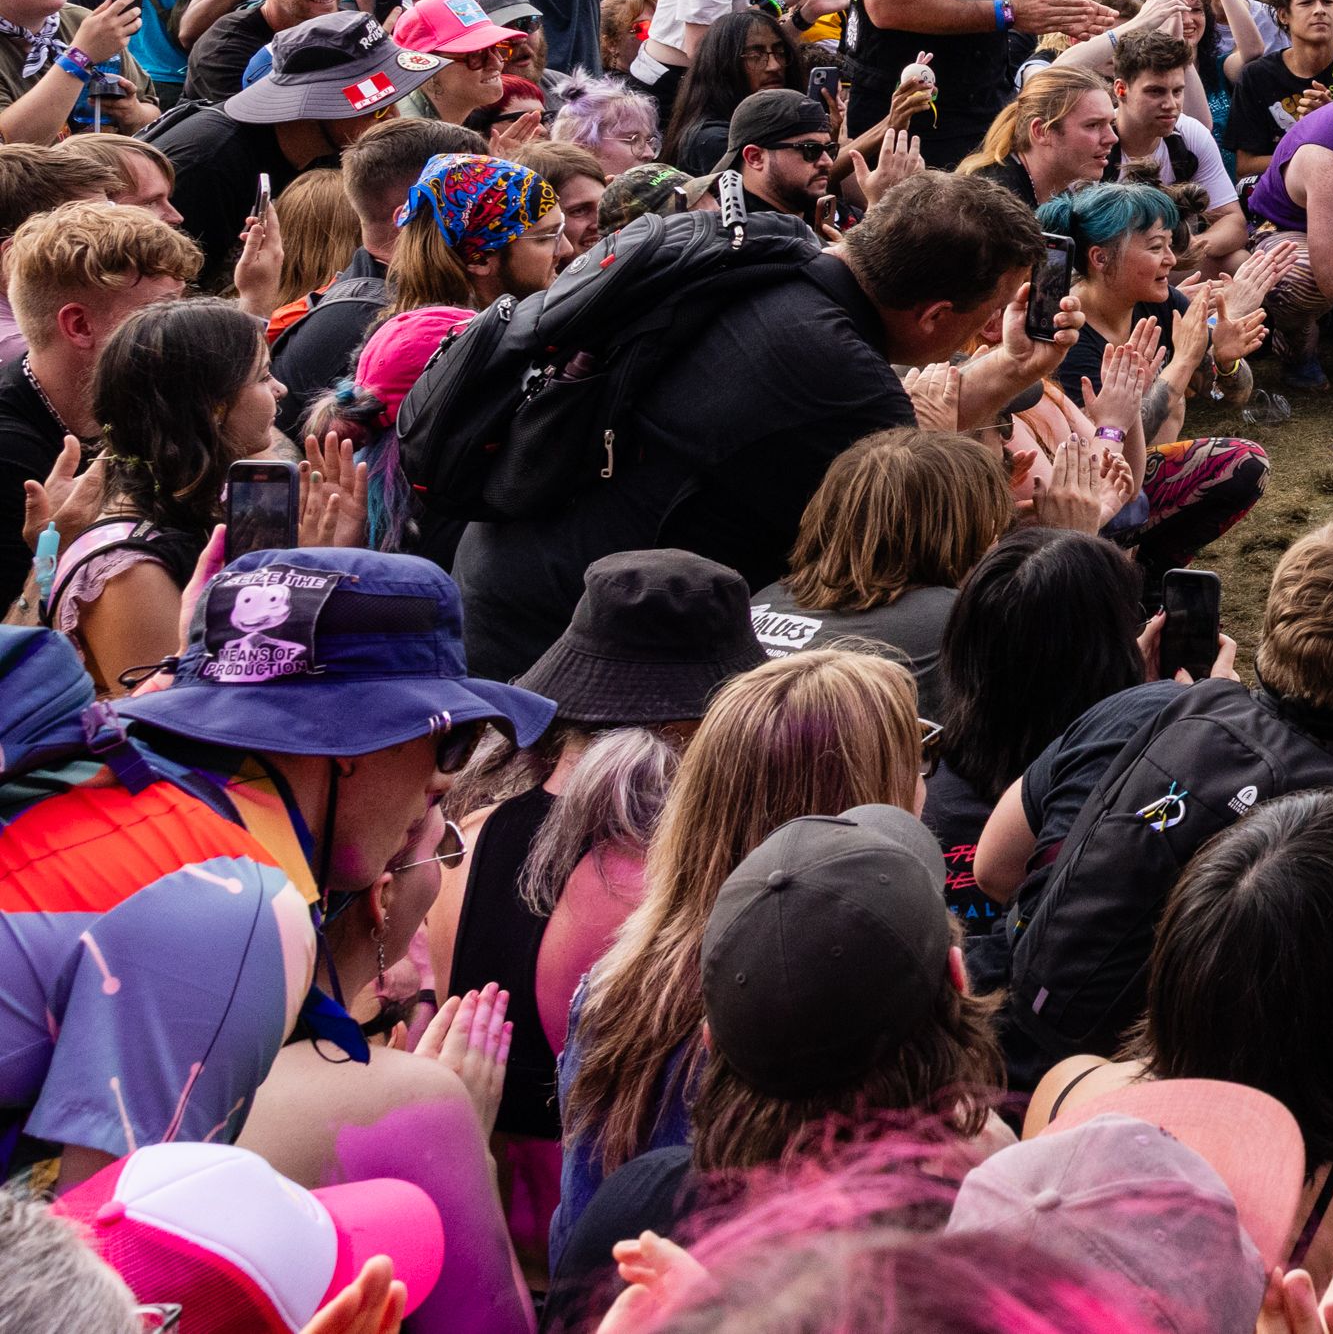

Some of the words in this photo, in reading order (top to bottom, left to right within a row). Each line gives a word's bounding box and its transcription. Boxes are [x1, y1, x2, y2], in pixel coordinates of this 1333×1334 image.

[360, 89, 393, 107] PERU
[284, 571, 328, 589] THE
[218, 647, 271, 663] MEANS
[273, 646, 295, 661] OF
[203, 659, 307, 677] PRODUCTION
